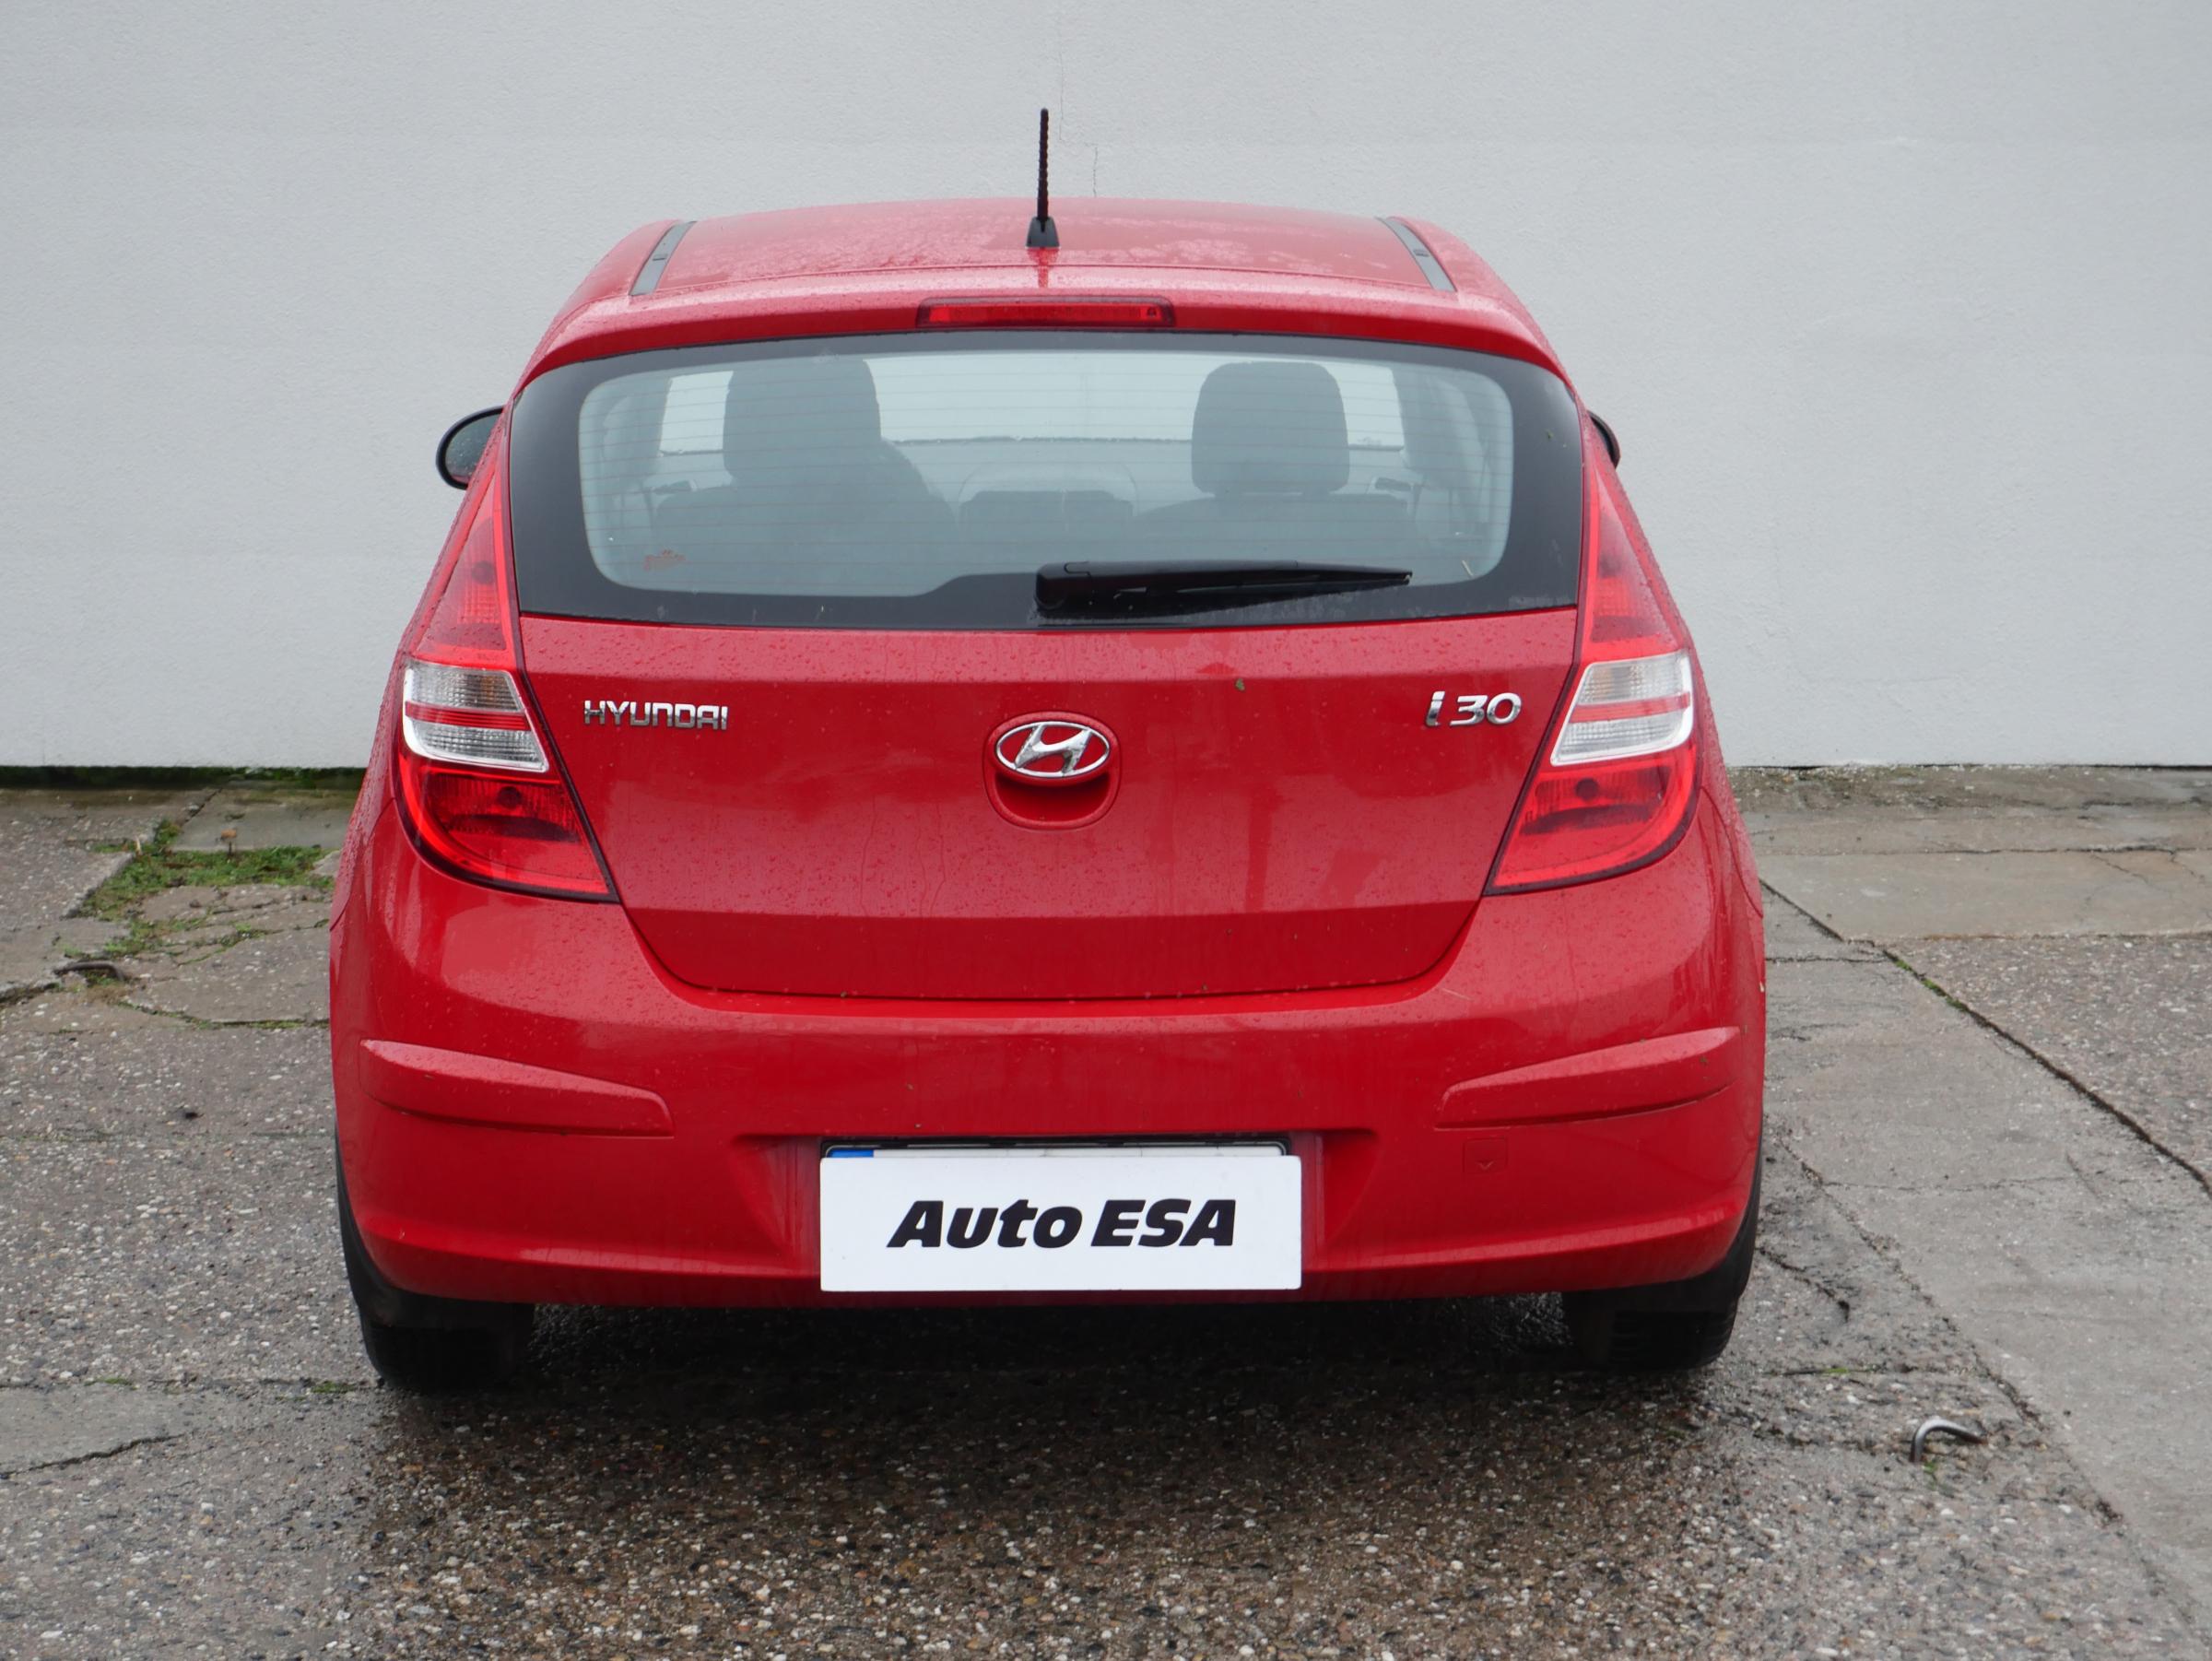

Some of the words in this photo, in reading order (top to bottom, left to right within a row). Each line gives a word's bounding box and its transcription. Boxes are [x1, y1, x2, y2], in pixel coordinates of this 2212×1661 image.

[583, 700, 729, 731] HYUNDAI
[886, 1199, 1083, 1249] Auto
[1090, 1198, 1236, 1247] ESA
